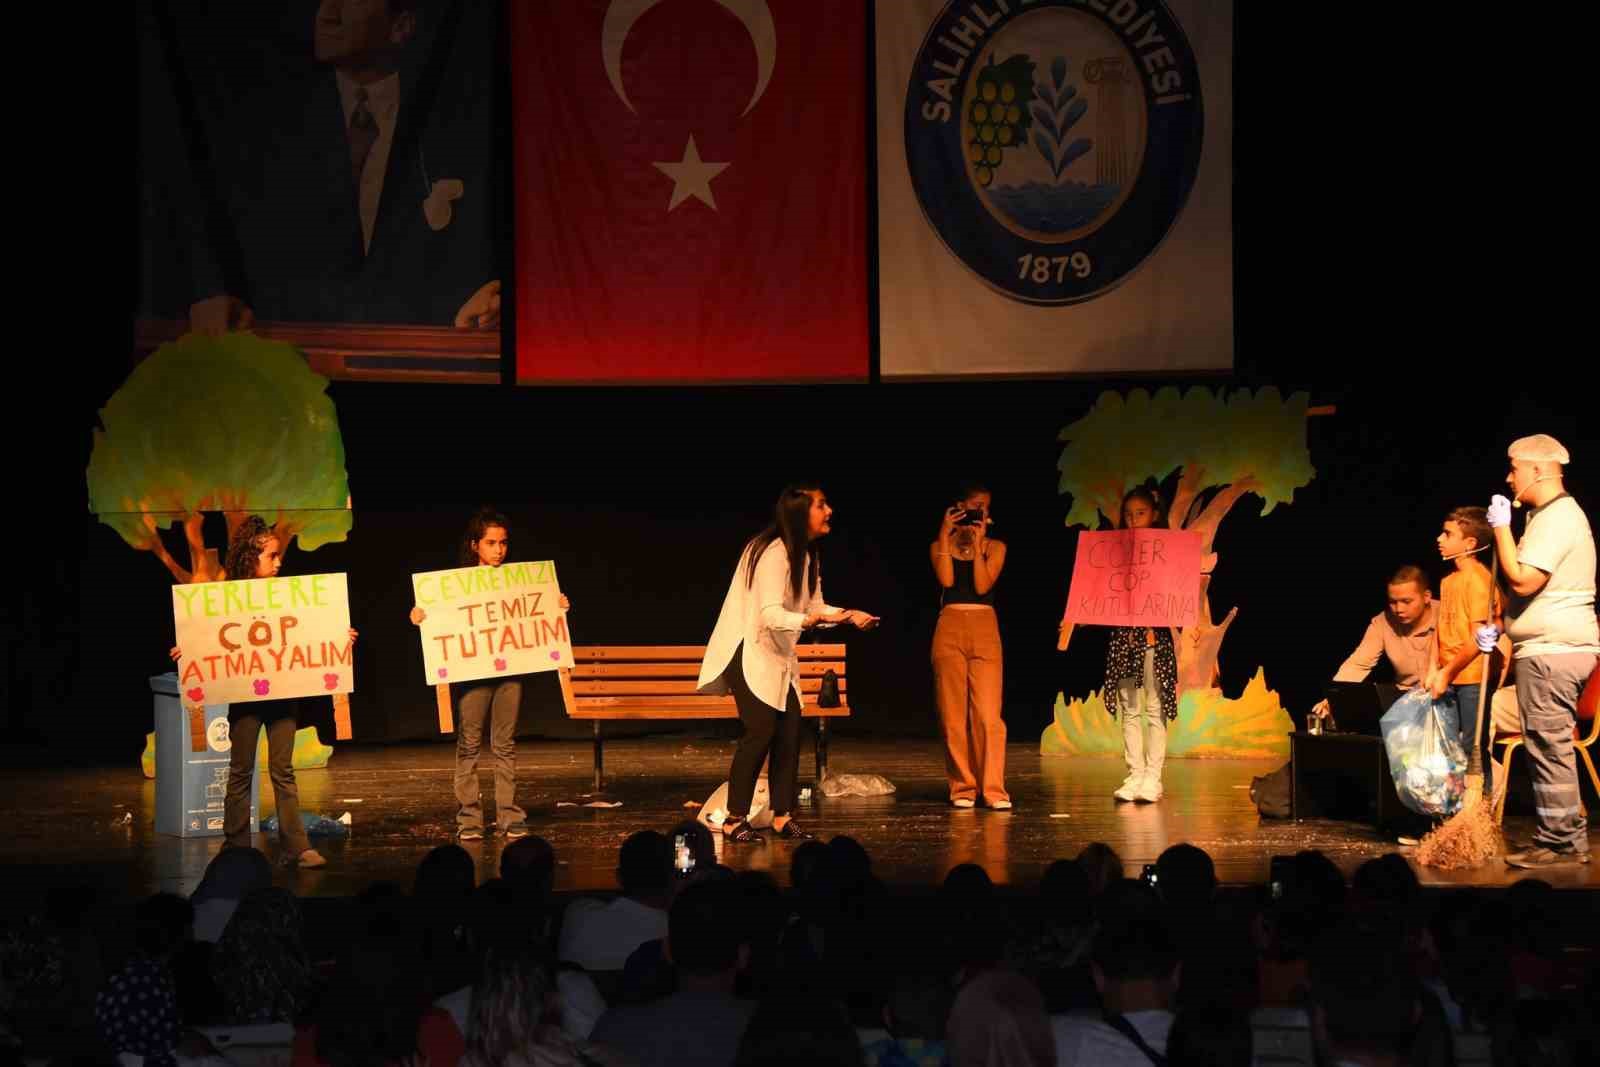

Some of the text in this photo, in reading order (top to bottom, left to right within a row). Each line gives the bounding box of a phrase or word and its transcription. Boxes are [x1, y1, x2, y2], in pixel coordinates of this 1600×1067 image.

[1016, 251, 1092, 284] 1879
[173, 576, 329, 618] YERLERE
[457, 592, 545, 627] TEMİZ
[218, 615, 299, 652] ÇÖP
[432, 615, 567, 662] TUTALIM
[181, 641, 352, 686] ATMAYALIM
